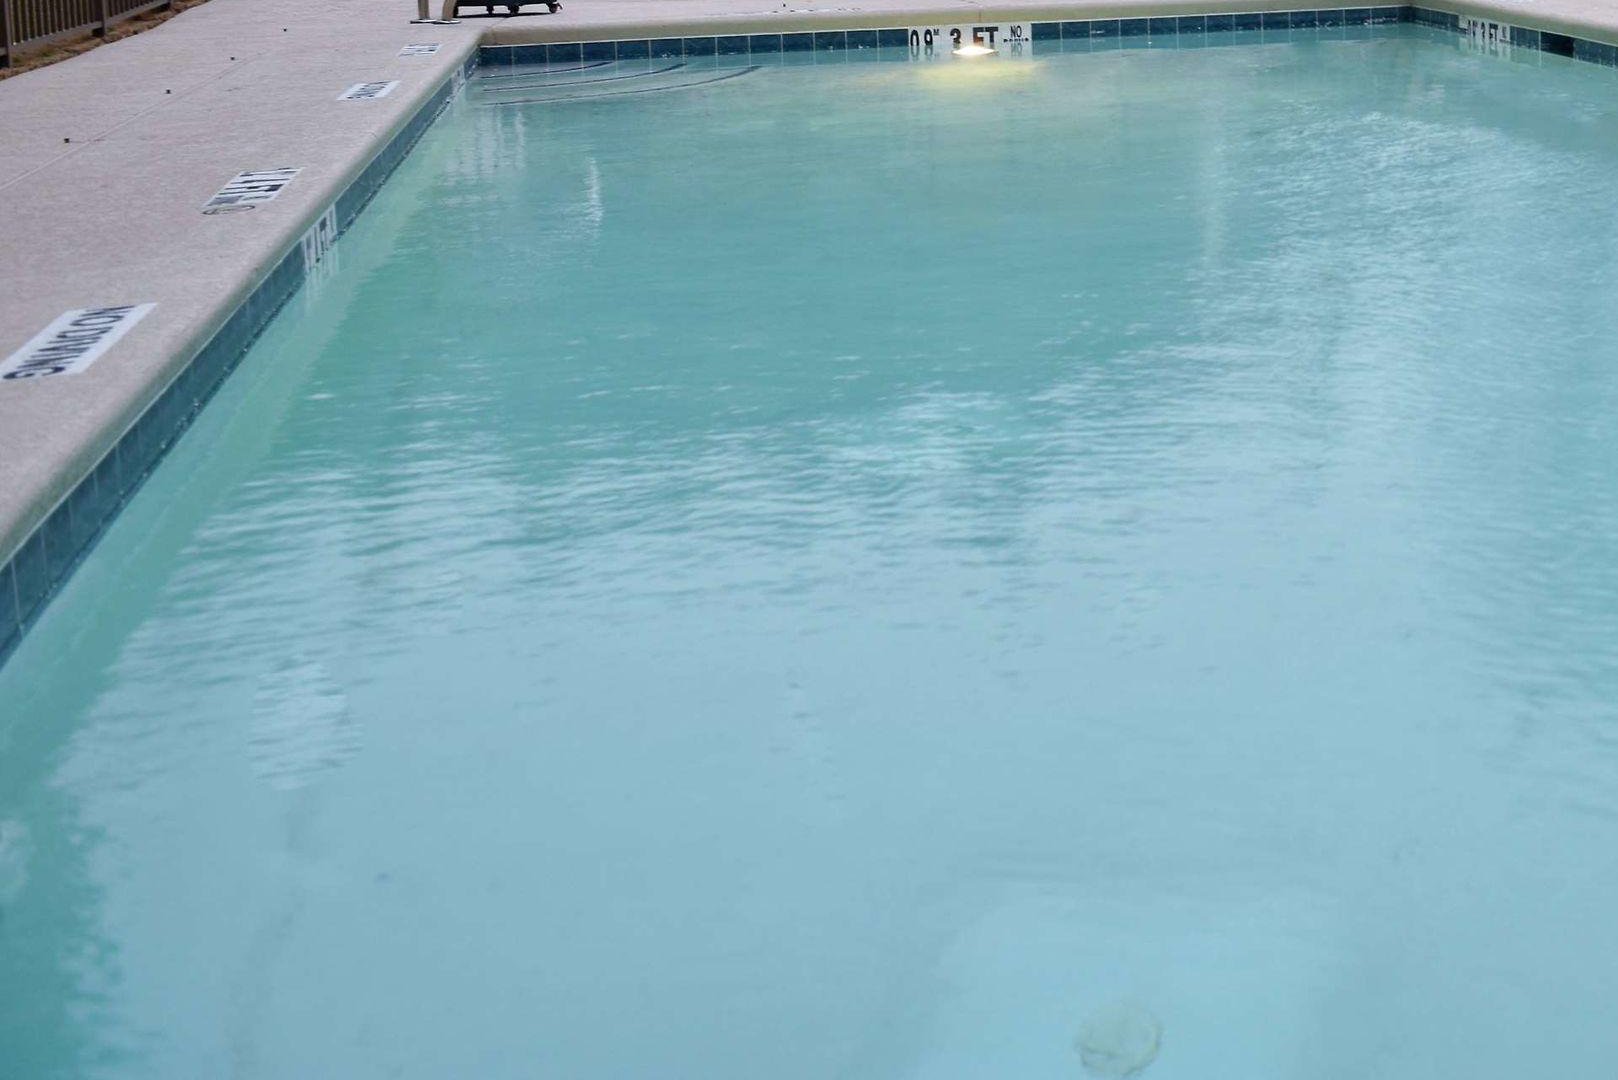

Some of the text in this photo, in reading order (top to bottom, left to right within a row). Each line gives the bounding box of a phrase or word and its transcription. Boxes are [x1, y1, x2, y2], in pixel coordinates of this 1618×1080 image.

[972, 26, 999, 44] FT
[1010, 25, 1022, 38] NO
[2, 305, 136, 380] NO DIVING
